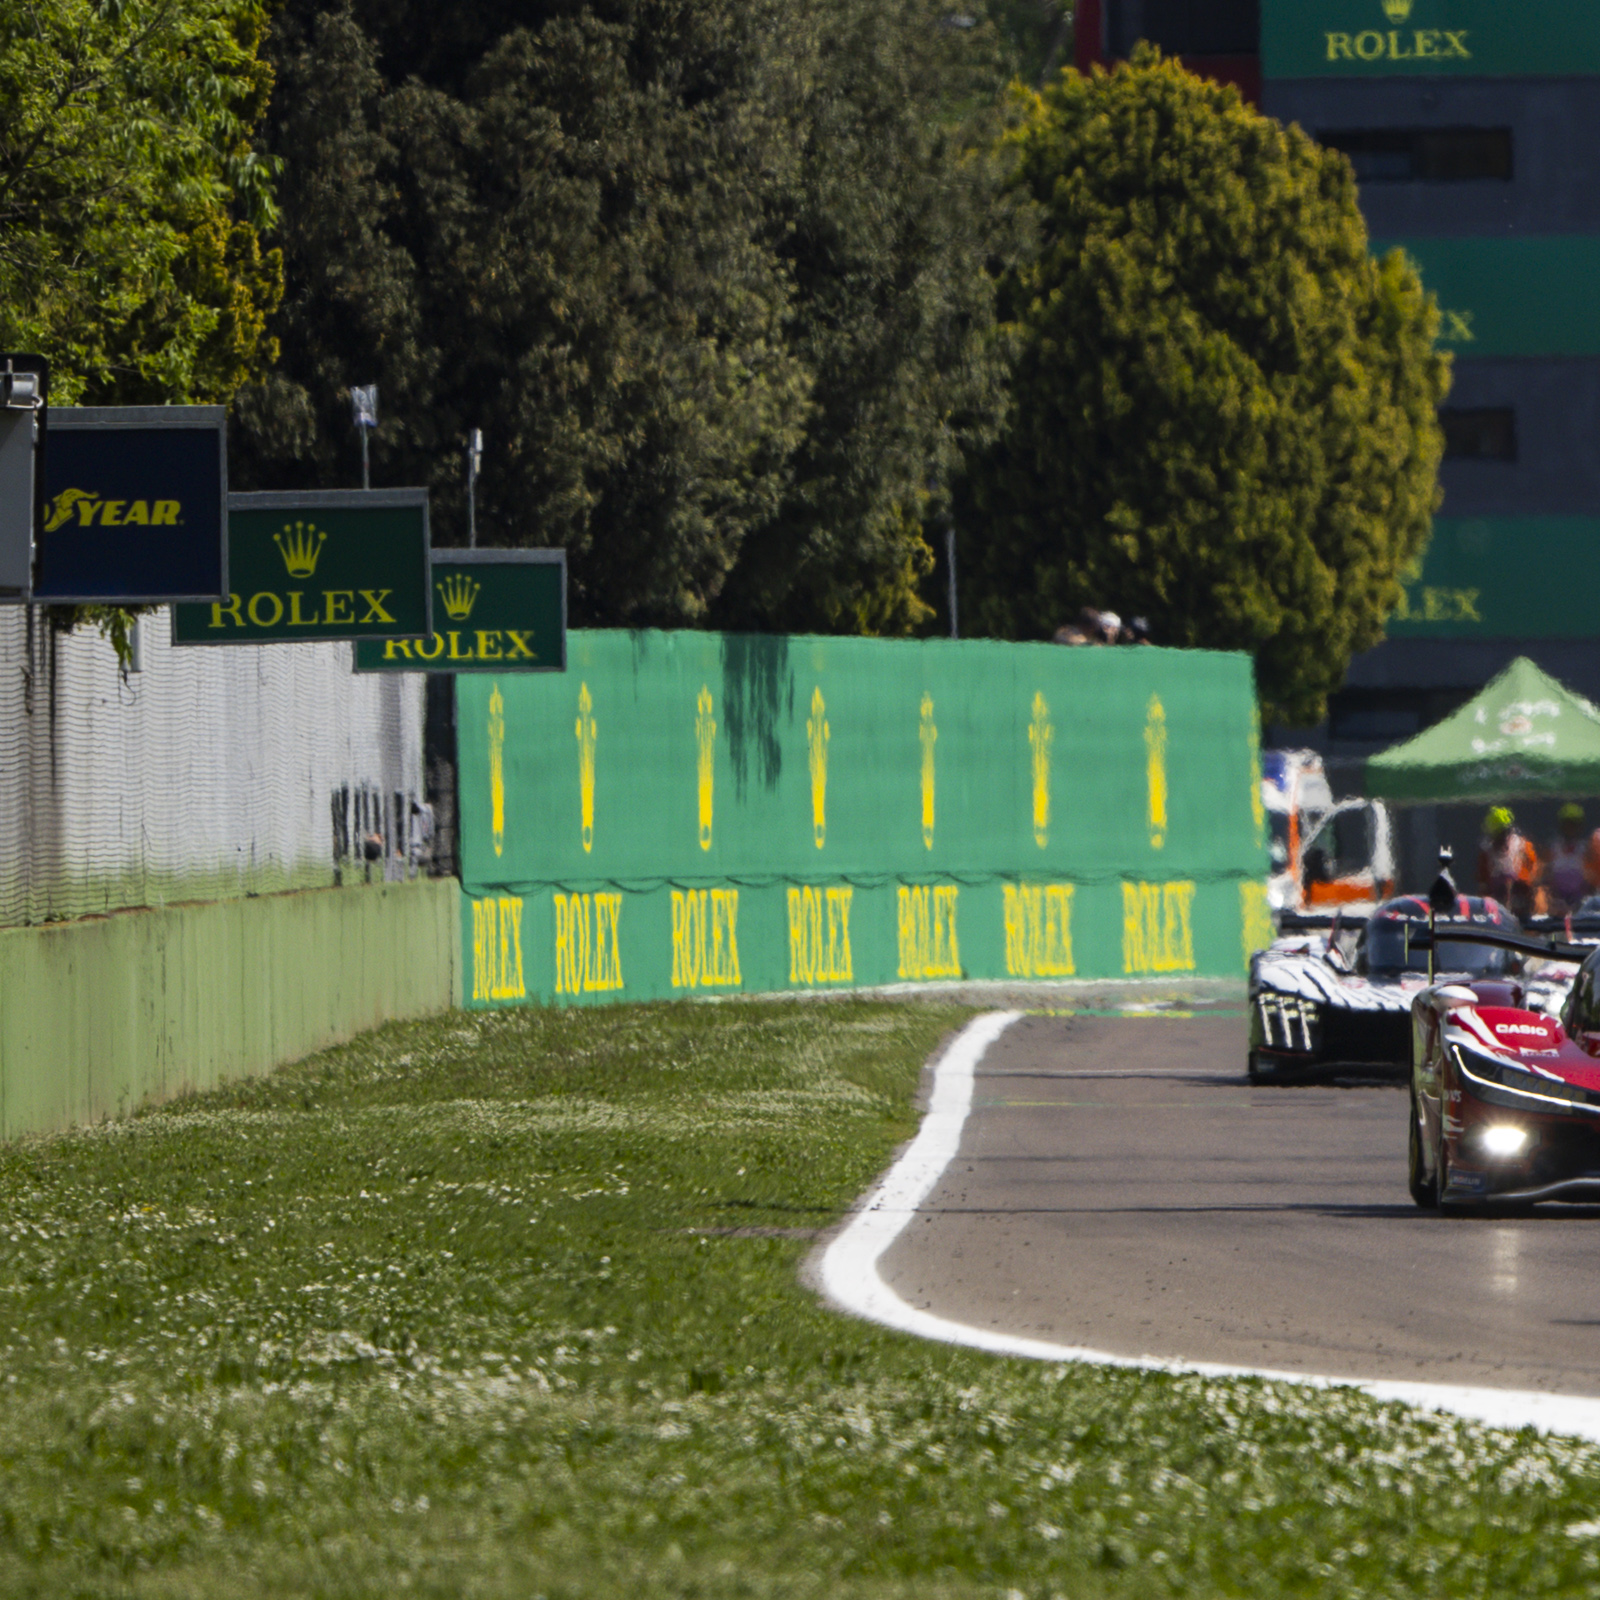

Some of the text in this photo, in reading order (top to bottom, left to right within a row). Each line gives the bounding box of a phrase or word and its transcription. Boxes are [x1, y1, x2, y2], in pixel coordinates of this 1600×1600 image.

[1325, 28, 1472, 62] ROLEX
[208, 588, 397, 628] ROLEX
[383, 631, 536, 661] ROLEX
[554, 892, 624, 995] ROLEX
[670, 888, 742, 987] ROLEX
[787, 885, 854, 984] ROLEX
[1495, 1023, 1549, 1037] CASIO
